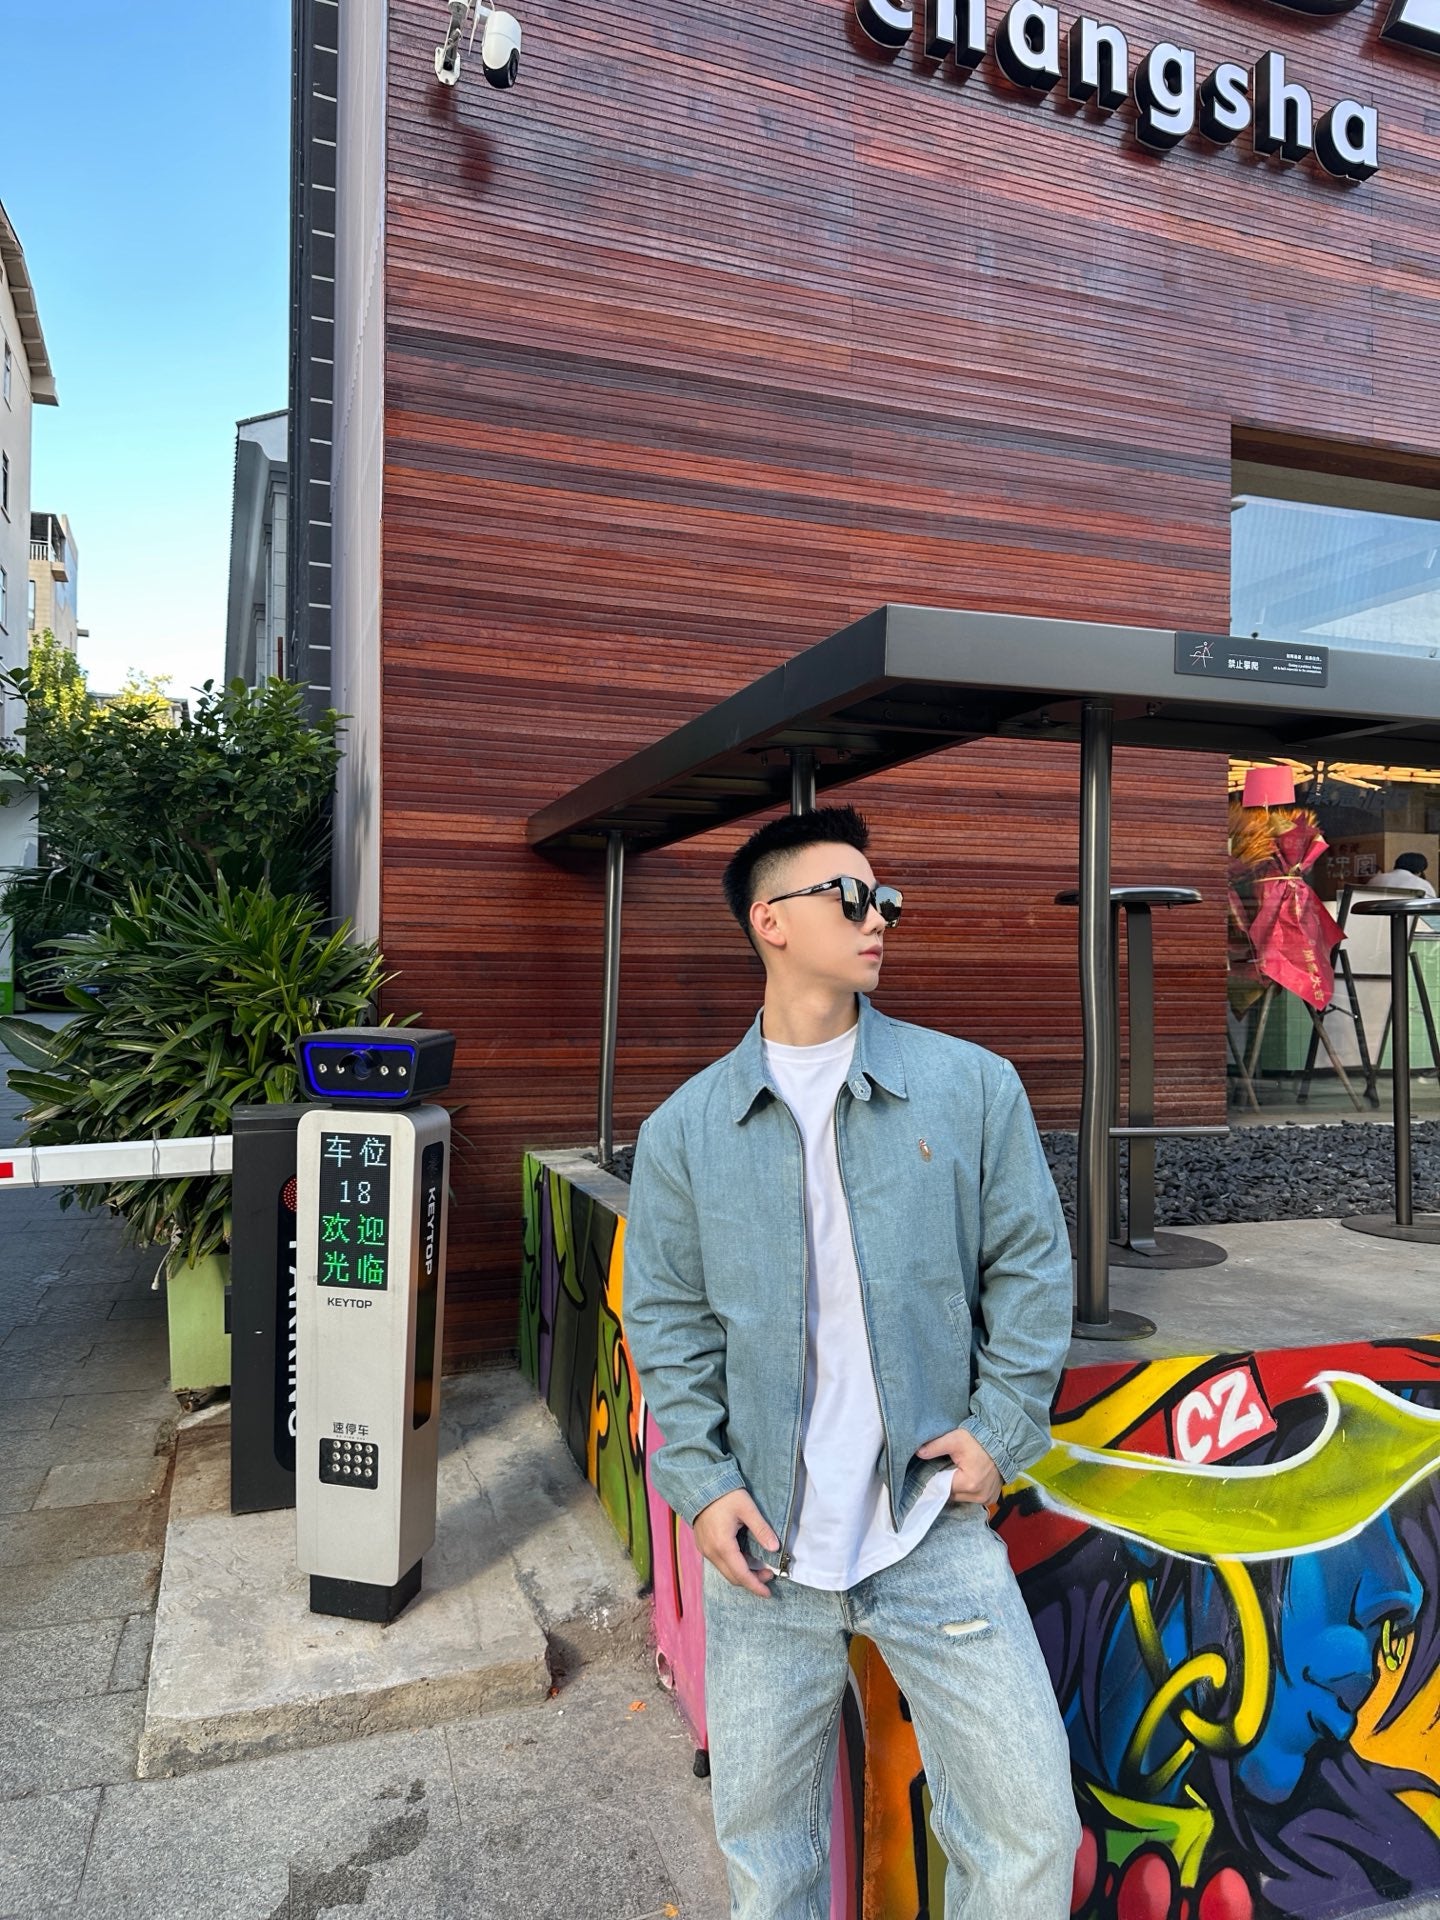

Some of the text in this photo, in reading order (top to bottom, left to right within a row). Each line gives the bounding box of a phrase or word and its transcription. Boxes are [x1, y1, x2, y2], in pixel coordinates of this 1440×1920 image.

[324, 1136, 387, 1168] 车位
[340, 1181, 371, 1204] 18
[321, 1213, 385, 1246] 欢迎
[425, 1186, 436, 1276] KEYTOP
[322, 1251, 385, 1285] 光临
[327, 1297, 373, 1309] KEYTOP
[333, 1421, 369, 1436] 速停车
